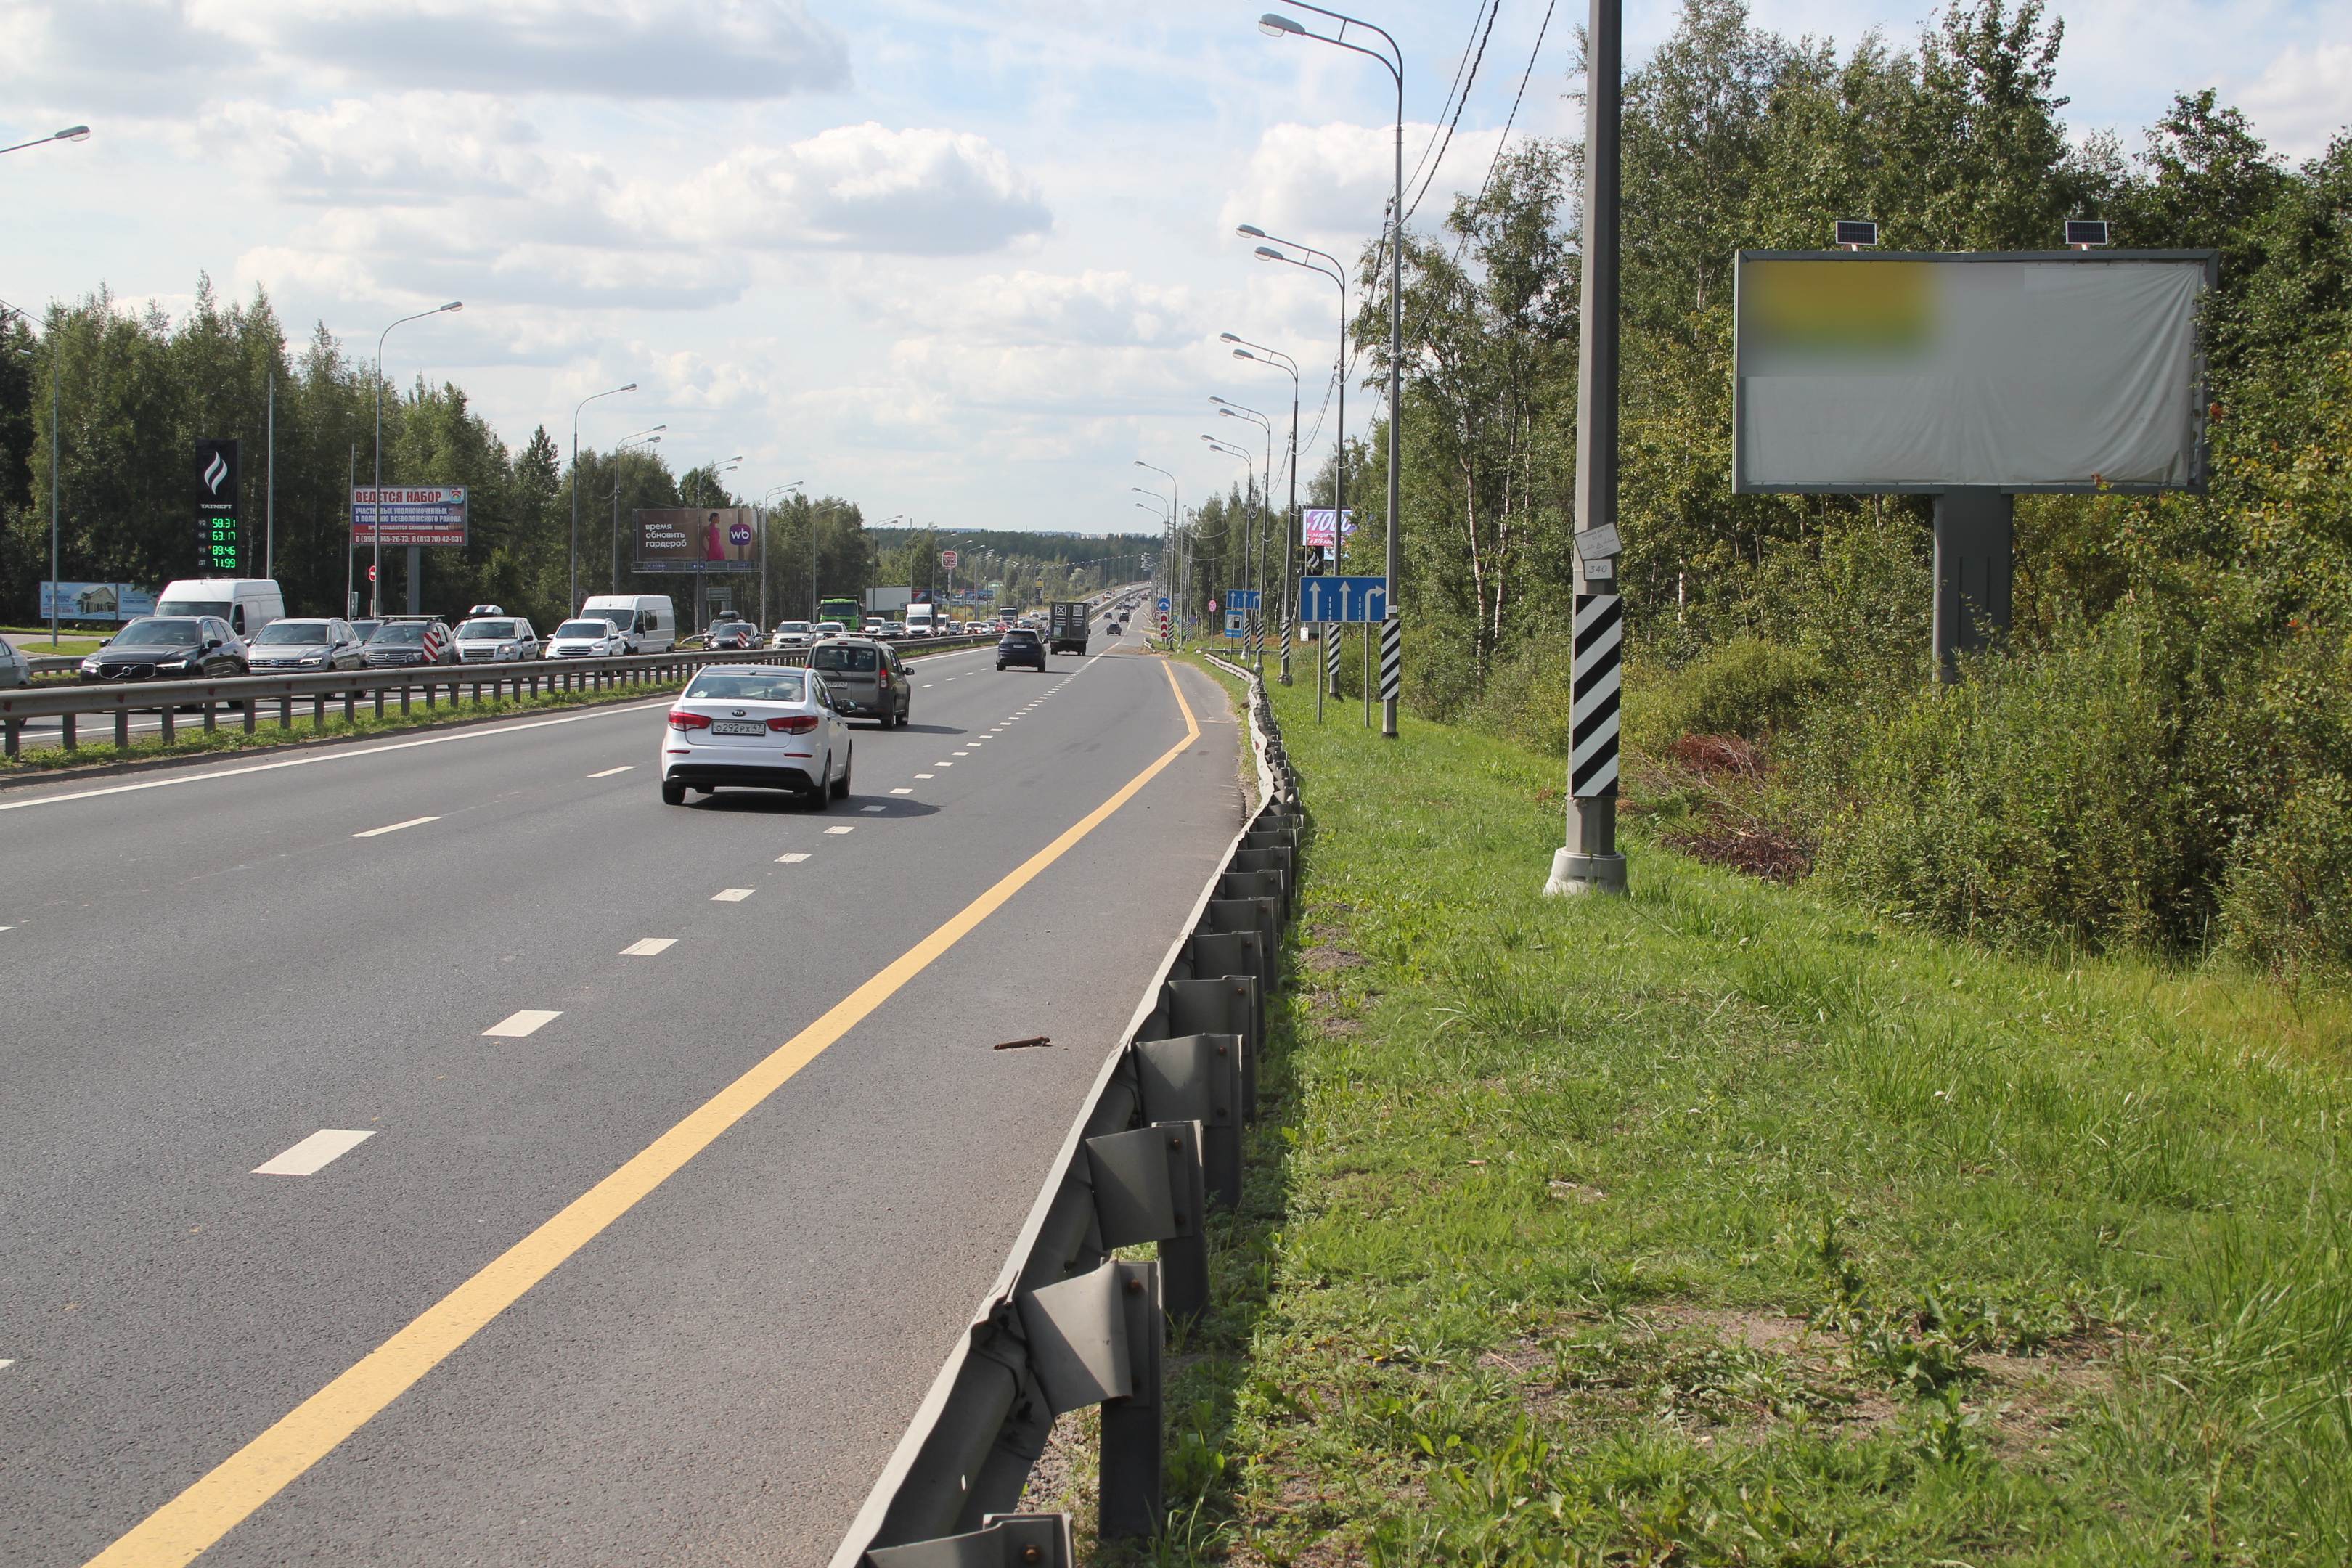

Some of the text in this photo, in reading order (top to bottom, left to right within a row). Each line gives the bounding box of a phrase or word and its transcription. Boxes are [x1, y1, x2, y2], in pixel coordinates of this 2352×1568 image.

[407, 491, 441, 502] НАБОР
[212, 518, 236, 528] 58.31
[212, 531, 236, 541] 63.17
[645, 531, 685, 539] обновить
[730, 528, 750, 539] wb
[645, 539, 687, 549] гардероб
[212, 545, 236, 555] 89.46
[213, 558, 236, 568] 71.99
[1588, 565, 1607, 574] 340
